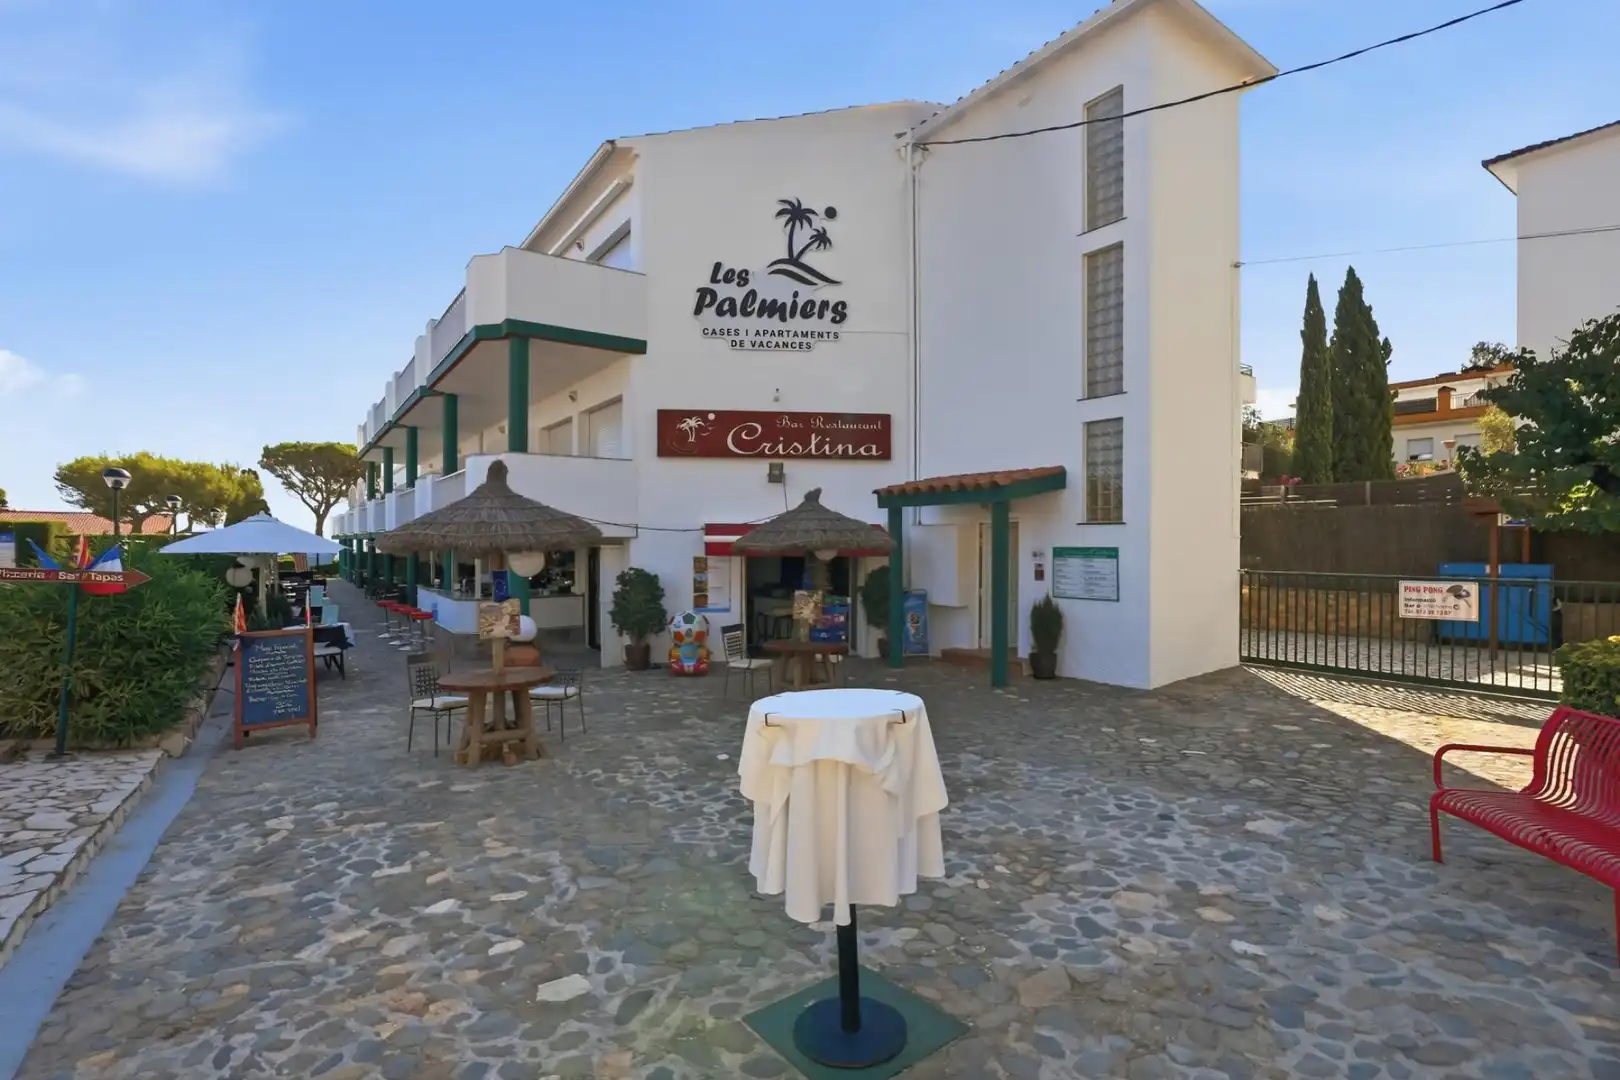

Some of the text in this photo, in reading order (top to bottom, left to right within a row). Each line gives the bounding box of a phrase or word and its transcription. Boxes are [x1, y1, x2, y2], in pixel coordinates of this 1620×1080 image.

[710, 261, 750, 287] Les
[693, 287, 848, 324] Palmiers
[702, 328, 740, 336] CASES
[754, 329, 839, 340] APARTAMENTS
[731, 340, 812, 350] DE VACANCES
[776, 415, 883, 430] Bar Restaurant
[726, 422, 883, 456] Cristina
[89, 571, 124, 583] Tapas
[1404, 585, 1443, 594] PING PONG
